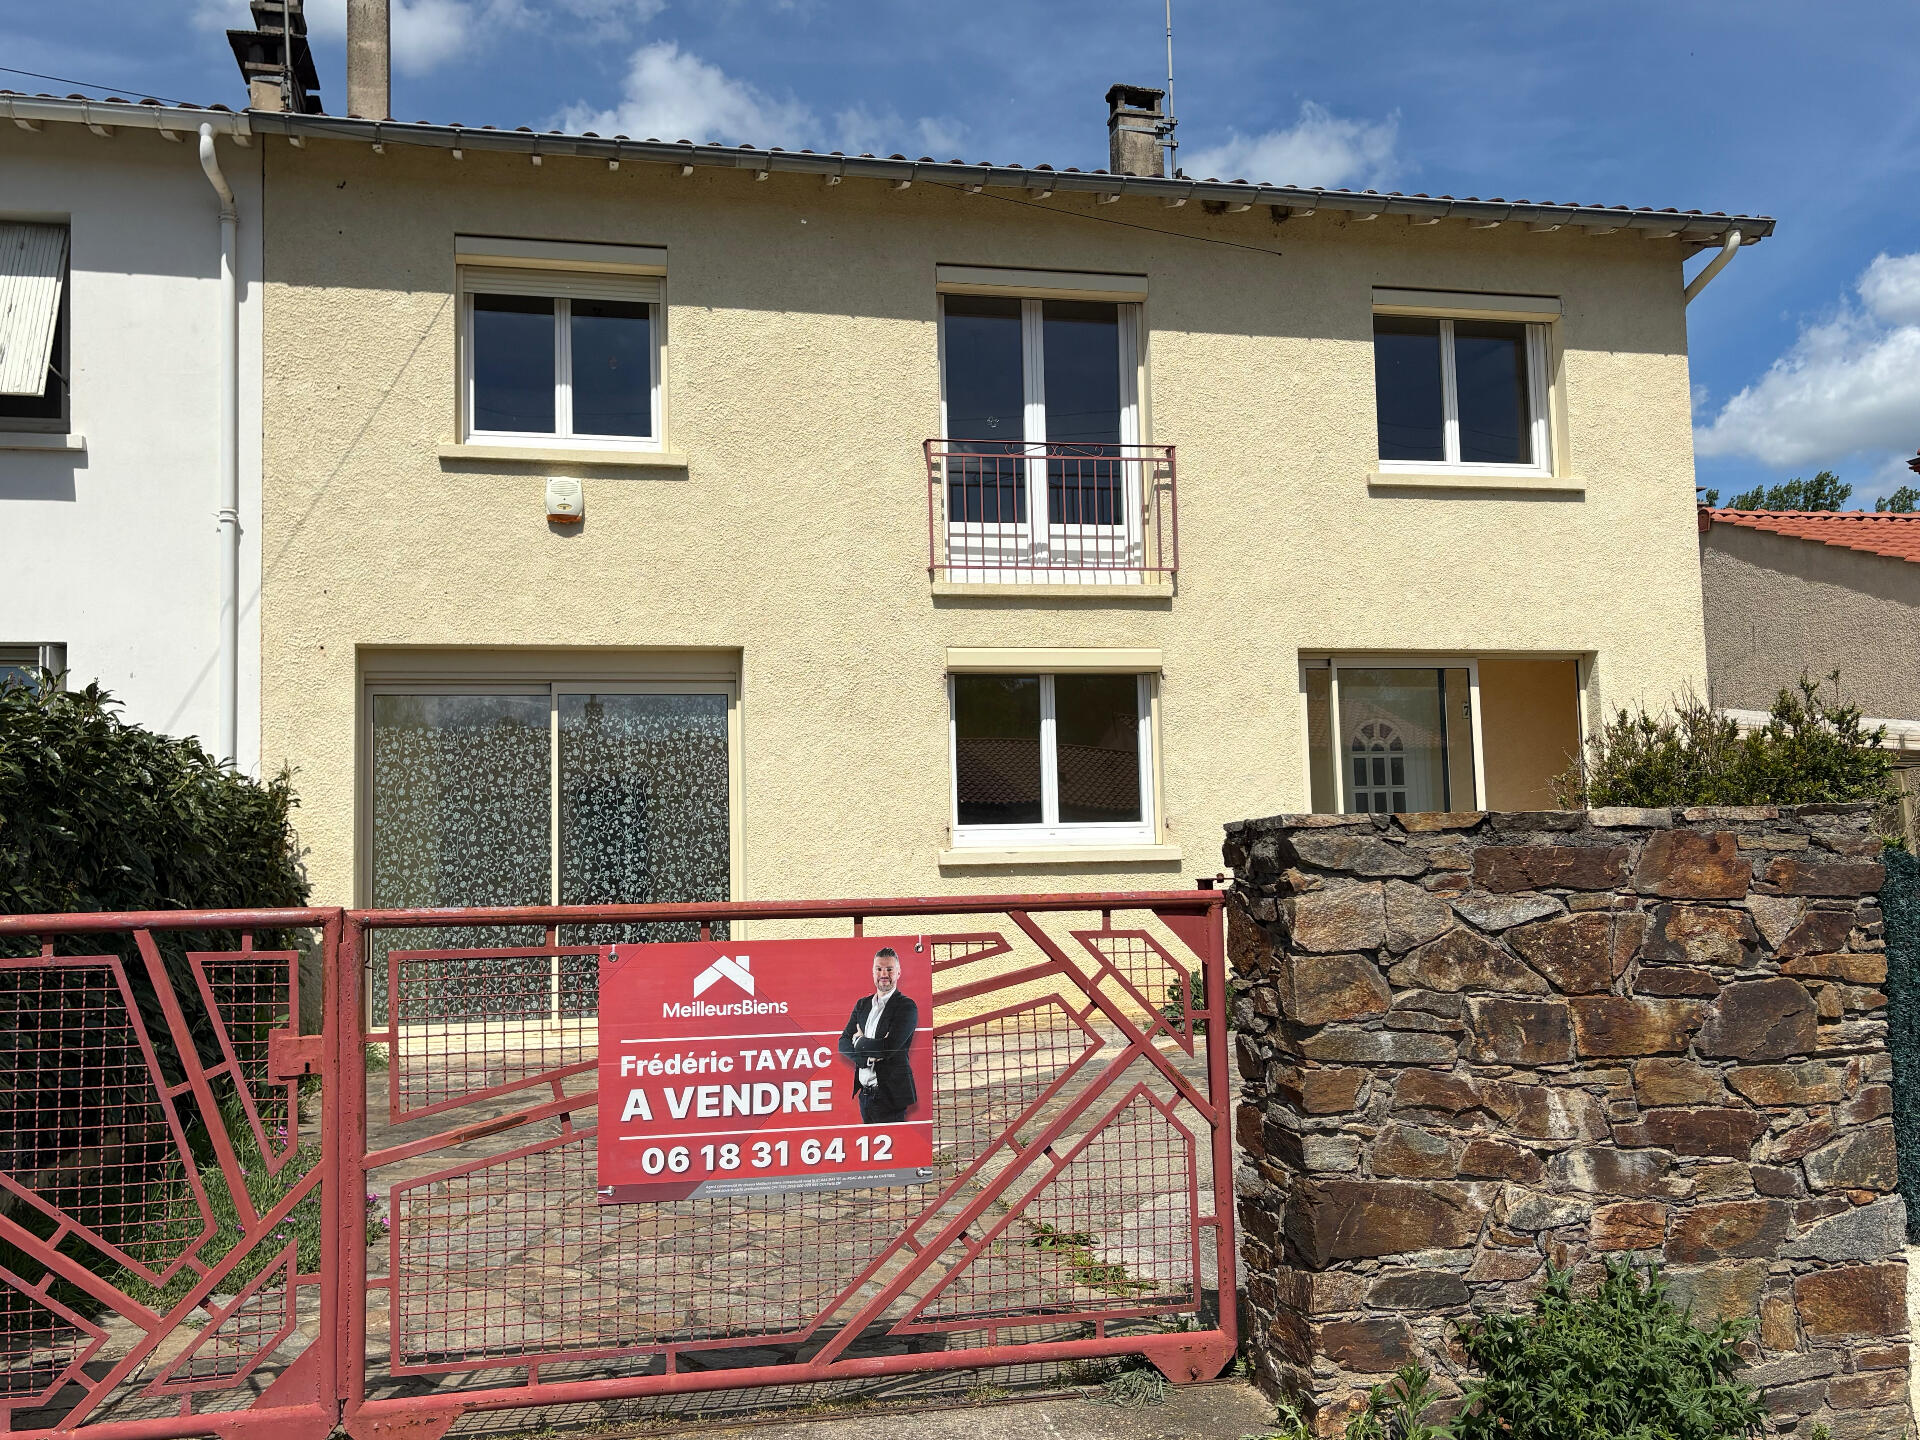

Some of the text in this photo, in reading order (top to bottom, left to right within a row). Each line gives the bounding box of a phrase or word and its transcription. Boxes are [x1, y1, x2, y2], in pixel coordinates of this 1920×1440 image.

[663, 999, 789, 1019] MeilleursBiens
[620, 1047, 832, 1077] Frédéric TAYAC
[620, 1079, 833, 1122] A VENDRE
[641, 1134, 893, 1175] 06 18 31 64 12
